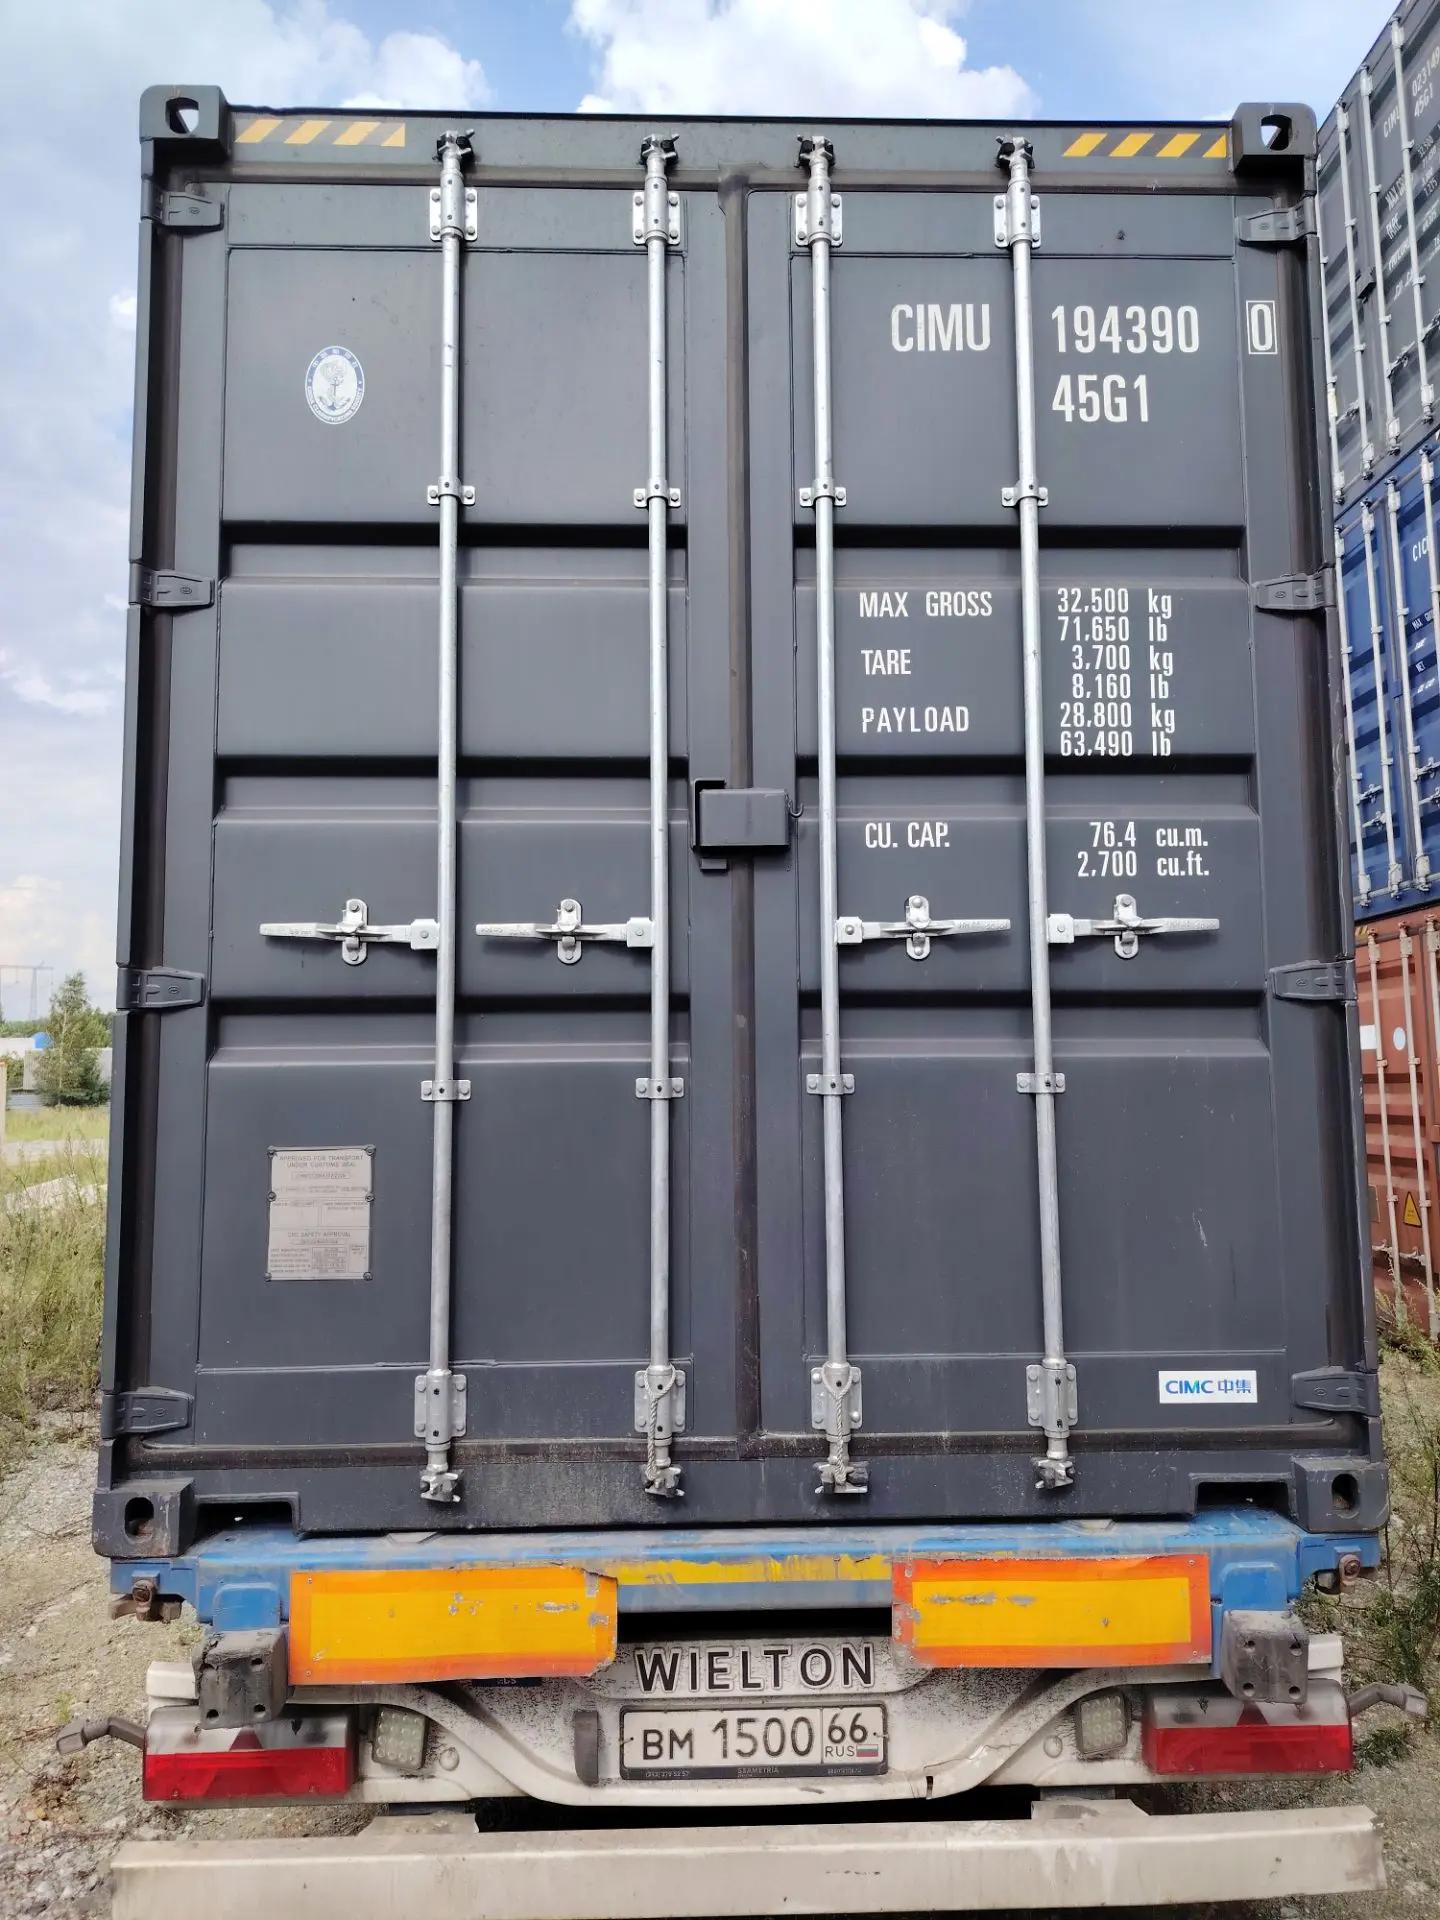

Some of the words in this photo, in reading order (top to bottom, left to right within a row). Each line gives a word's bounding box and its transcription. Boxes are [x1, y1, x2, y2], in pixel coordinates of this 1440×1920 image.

[891, 303, 991, 353] CIMU
[1051, 305, 1200, 354] 194390
[1251, 304, 1273, 351] 0
[1052, 374, 1149, 423] 45G1
[860, 591, 909, 618] MAX
[925, 591, 993, 617] GROSS
[1057, 588, 1129, 614] 32,500
[1148, 588, 1172, 617] kg
[1058, 616, 1130, 642] 71,650
[1149, 616, 1168, 642] lb
[861, 650, 912, 675] TARE
[1071, 645, 1131, 671] 3,700
[1149, 645, 1174, 677] kg
[1072, 674, 1131, 700] 8,160
[1150, 674, 1170, 700] lb
[862, 706, 969, 734] PAYLOAD
[1060, 702, 1132, 728] 28,800
[1151, 702, 1176, 734] kg
[1060, 731, 1133, 757] 63,490
[1152, 731, 1172, 757] lb
[865, 822, 898, 848] CU.
[907, 822, 950, 848] CAP.
[1089, 821, 1137, 847] 76.4
[1156, 825, 1209, 848] cu.m.
[1077, 851, 1137, 877] 2,700
[1156, 852, 1210, 877] cu.ft.
[1165, 1380, 1214, 1394] CIMC
[1217, 1378, 1252, 1394] 中集
[636, 1646, 874, 1692] WIELTON
[642, 1728, 694, 1760] BM
[711, 1717, 814, 1758] 1500
[827, 1713, 869, 1745] 66
[824, 1745, 855, 1757] RUS
